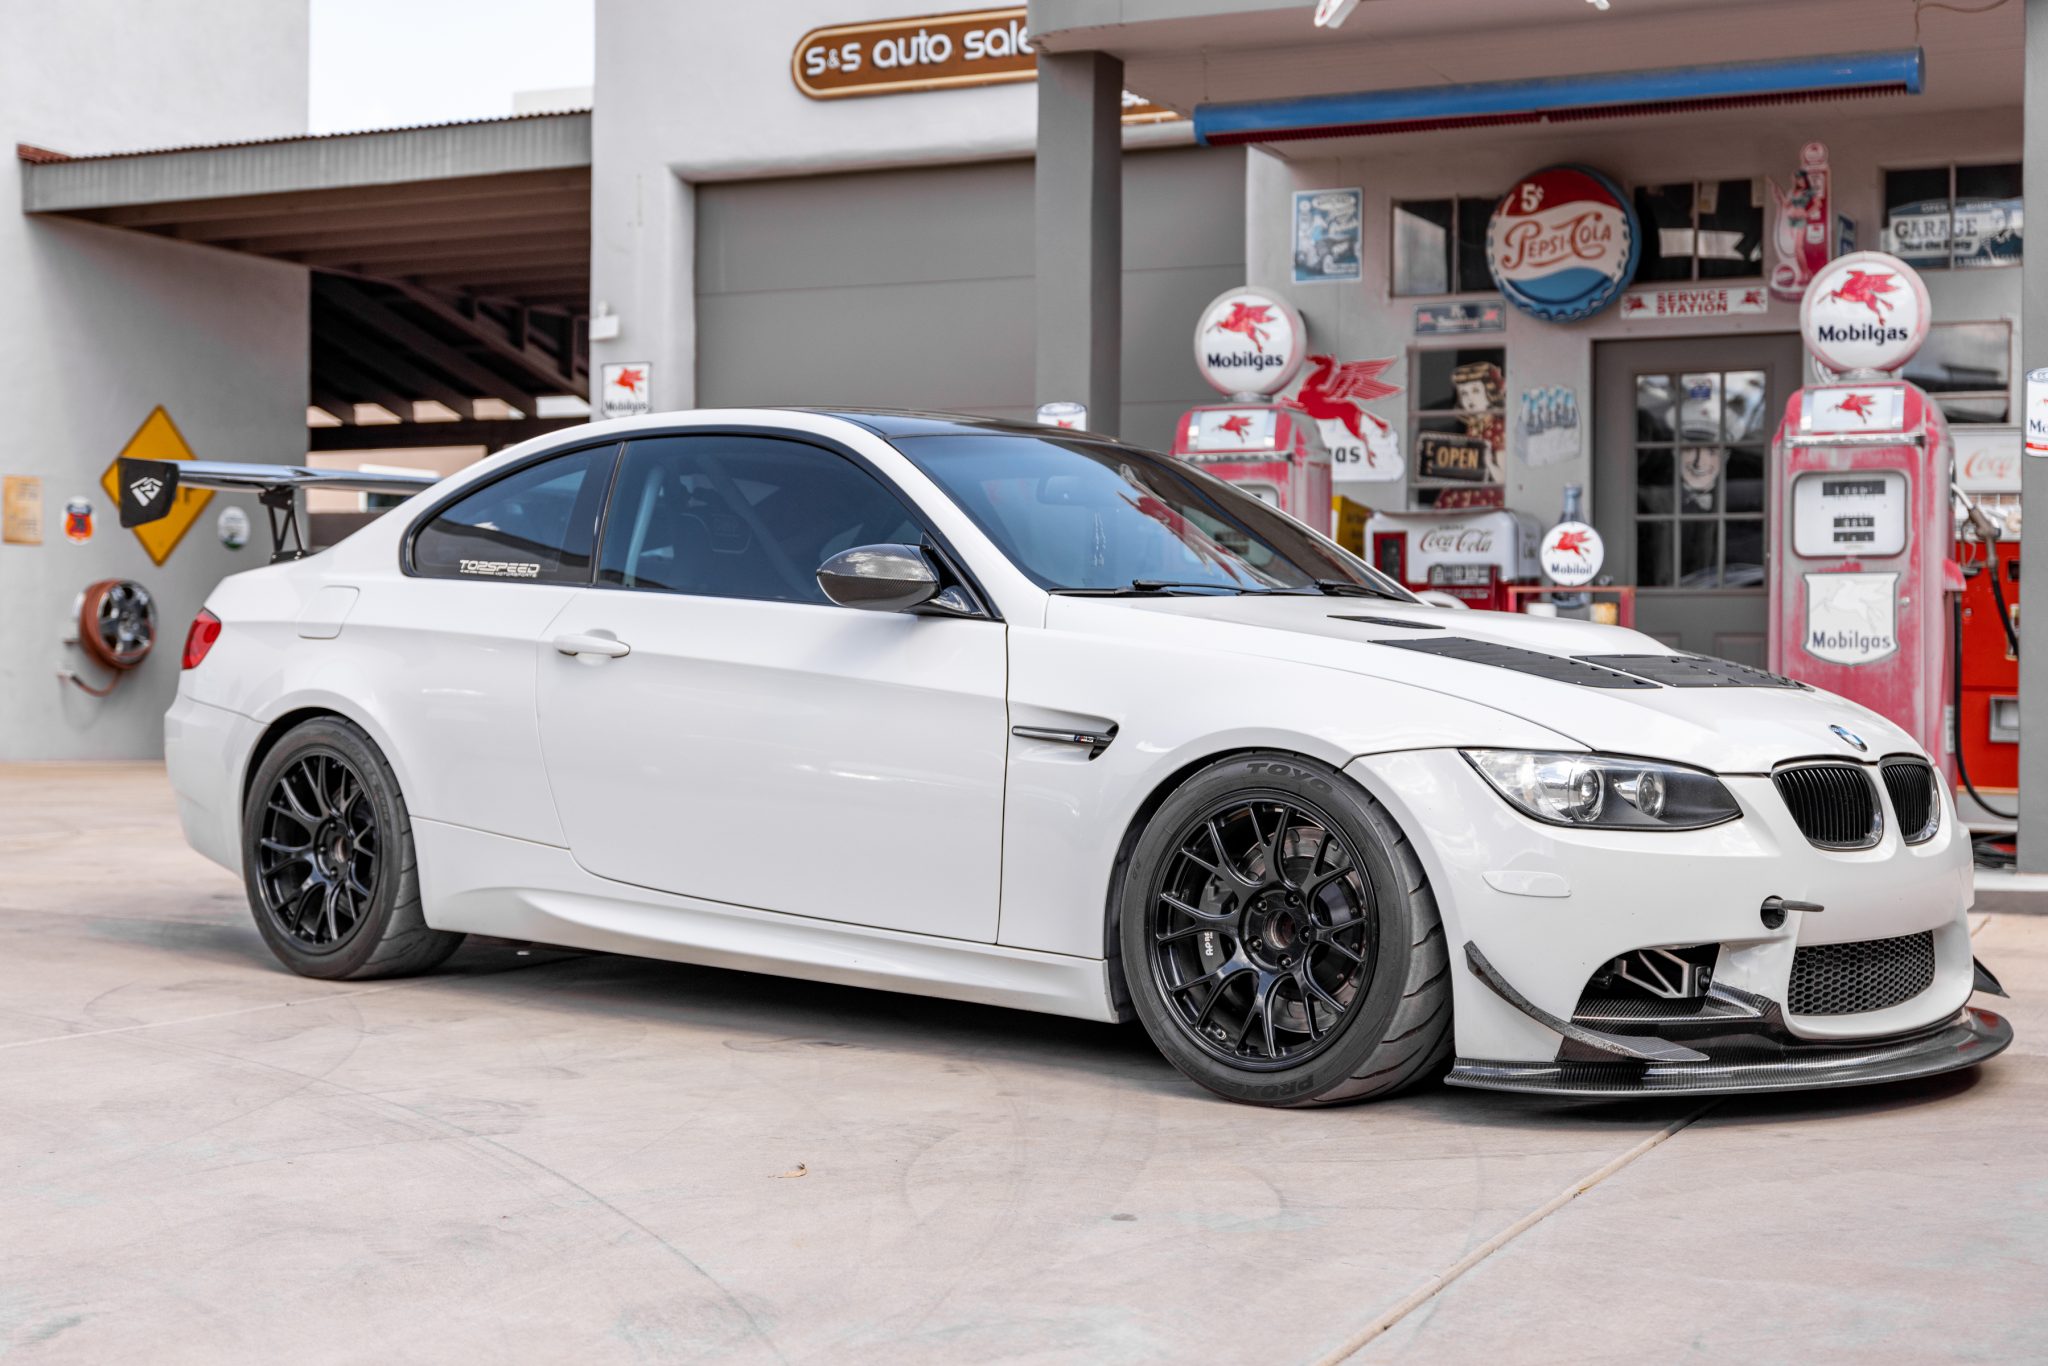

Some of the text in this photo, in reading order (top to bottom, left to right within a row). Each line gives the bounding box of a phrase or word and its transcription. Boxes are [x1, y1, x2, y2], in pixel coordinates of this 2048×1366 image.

[872, 28, 953, 70] auto
[1894, 216, 1978, 239] GARAGE
[1656, 290, 1728, 303] SERVICE
[1656, 303, 1728, 316] STATION
[1818, 323, 1908, 346] Mobilgas
[1207, 351, 1284, 372] Mobilgas
[1437, 446, 1479, 470] OPEN
[460, 559, 540, 574] TOPSPEED
[1551, 563, 1592, 575] Mobiloil
[1812, 630, 1891, 654] Mobilgas
[1246, 762, 1333, 793] TOYO
